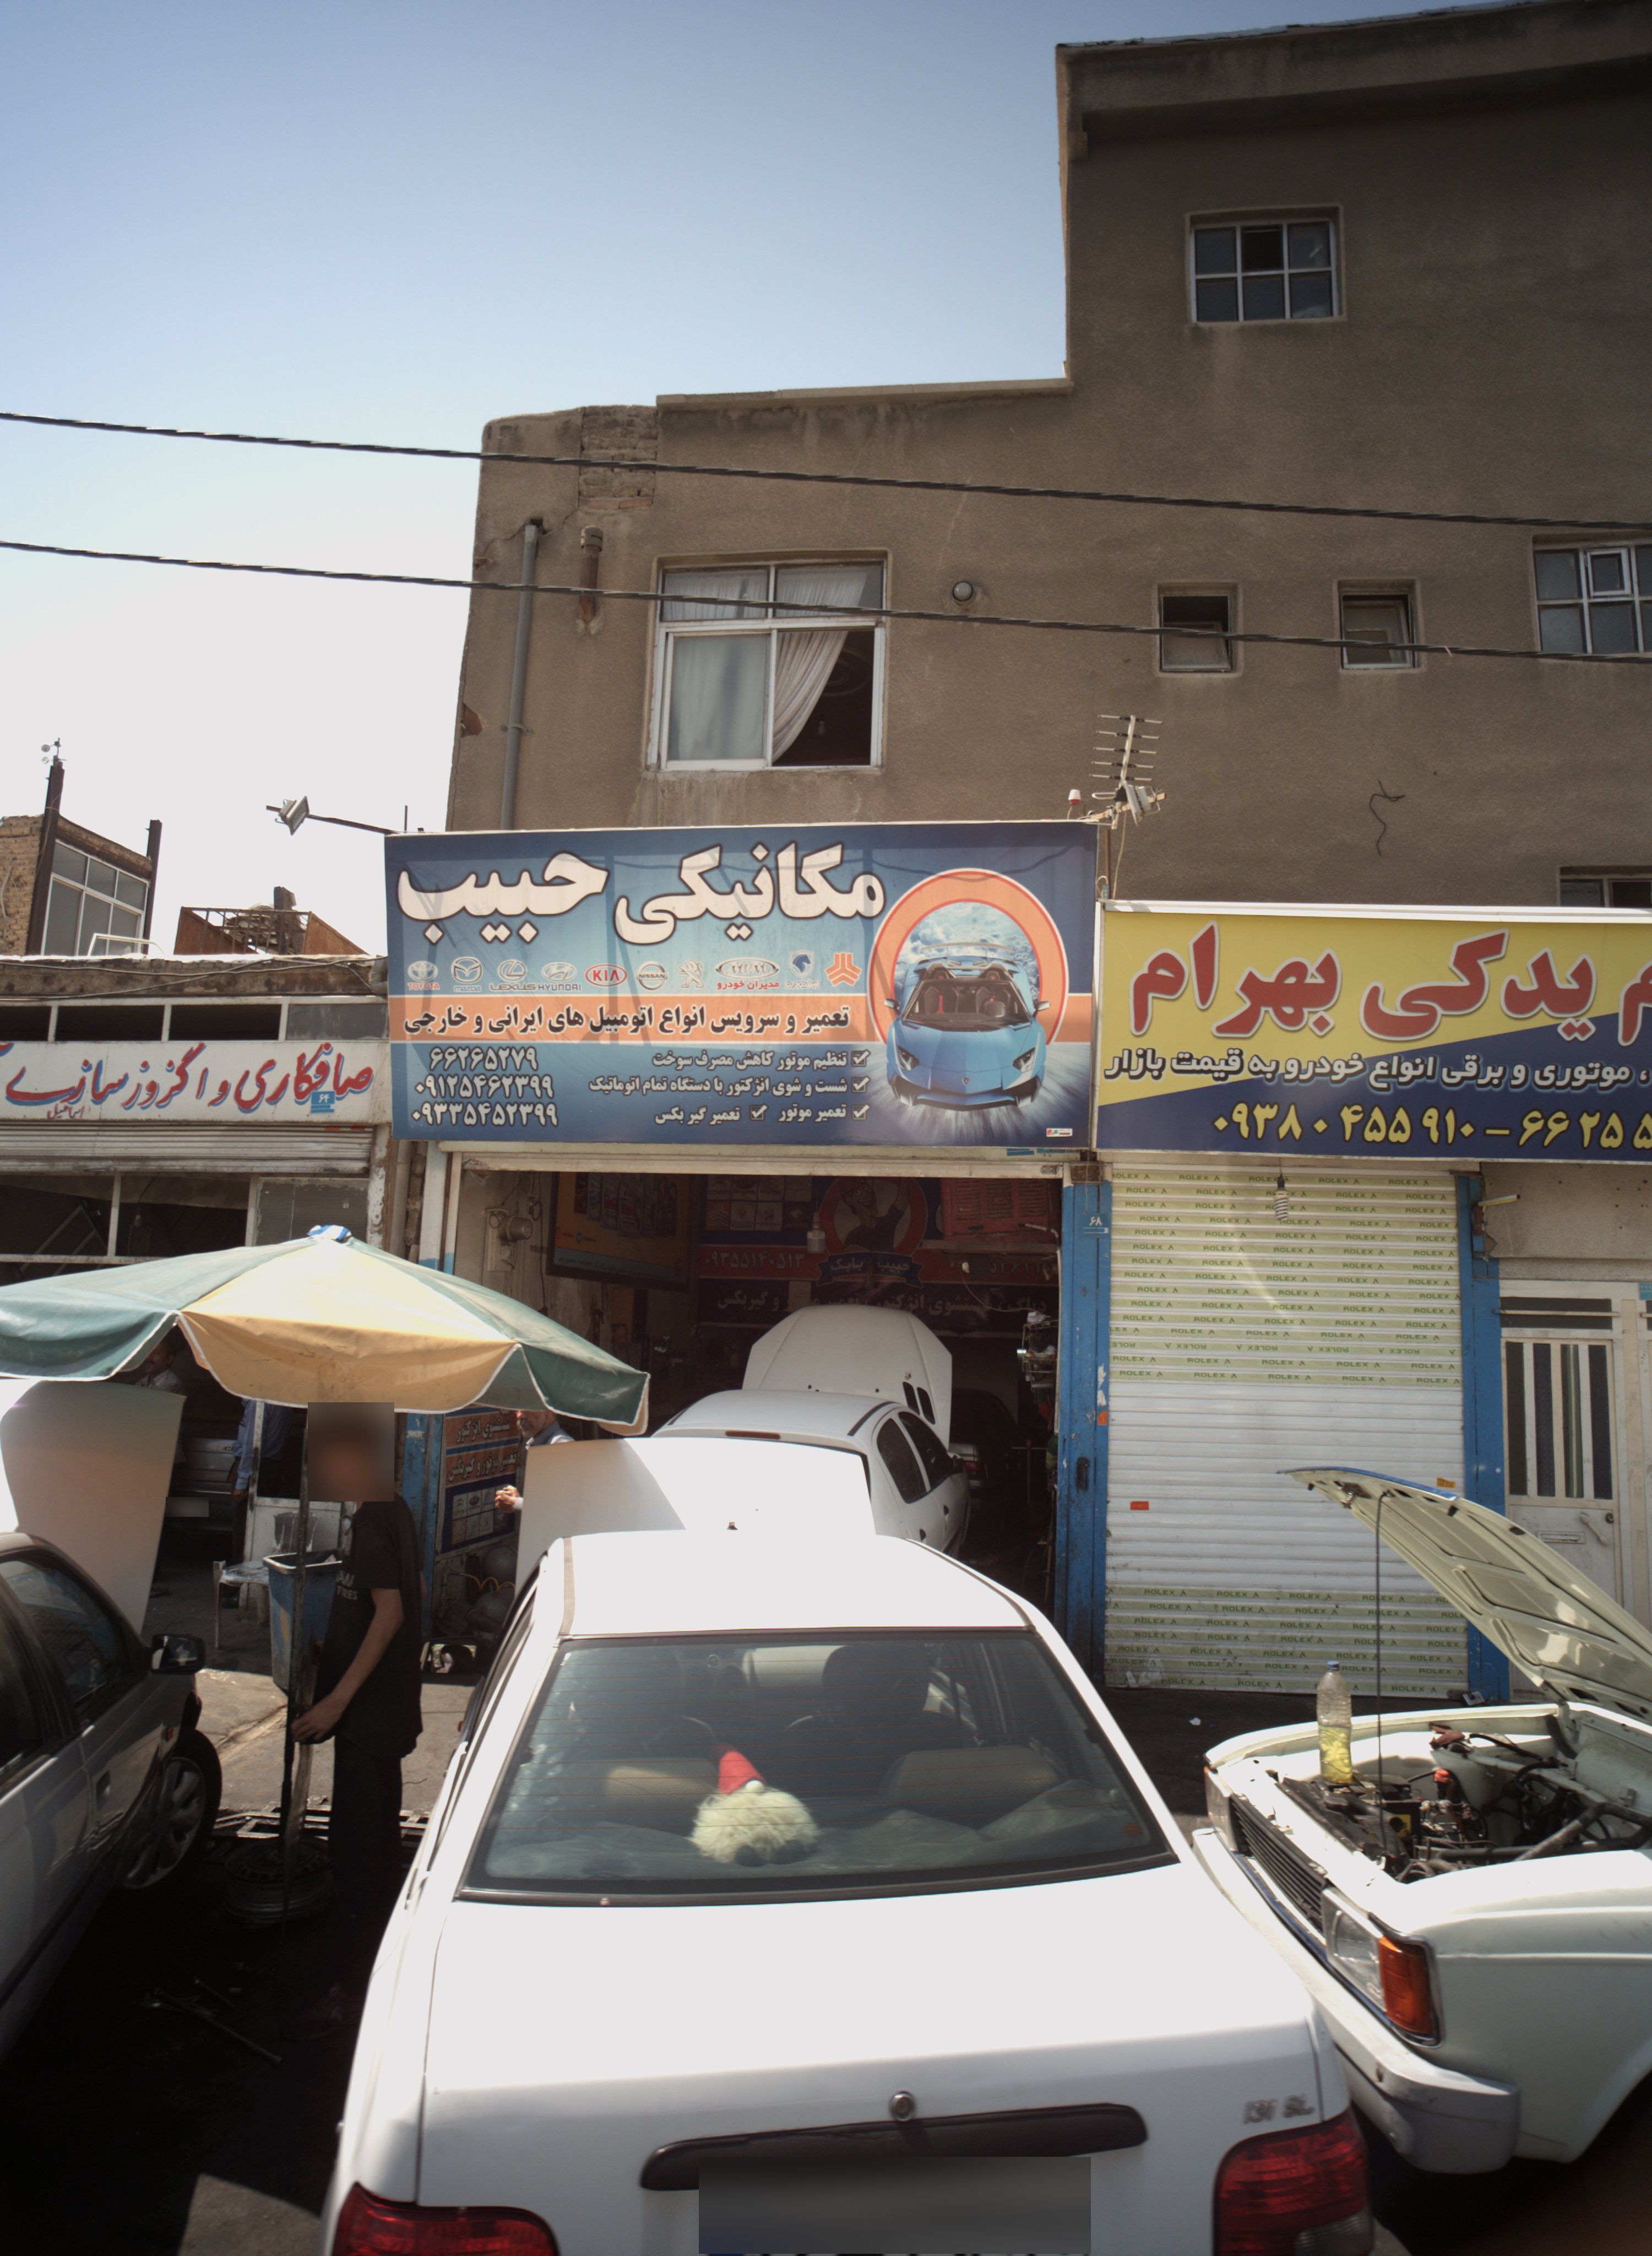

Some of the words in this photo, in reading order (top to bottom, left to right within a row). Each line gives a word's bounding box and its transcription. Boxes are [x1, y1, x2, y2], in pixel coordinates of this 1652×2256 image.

[397, 849, 610, 943] حبیب
[613, 840, 885, 946] مکانیکی
[592, 968, 620, 982] KIA
[717, 980, 745, 990] خودرو
[747, 980, 780, 990] مدیران
[1129, 920, 1341, 1038] بهرام
[1359, 928, 1597, 1042] یدکی
[407, 982, 439, 990] TOYOTA
[404, 1005, 468, 1034] خارجی
[473, 1014, 483, 1034] و
[488, 1005, 542, 1034] ایرانی
[548, 1006, 585, 1033] های
[590, 1005, 654, 1034] اتومبیل
[659, 1004, 705, 1034] انواع
[710, 1011, 780, 1034] سرویس
[785, 1013, 796, 1033] و
[802, 1005, 850, 1034] تعمیر
[430, 1046, 538, 1071] ۶۶۲۶۵۲۷۹
[652, 1052, 692, 1070] سوخت
[695, 1050, 733, 1070] مصرف
[736, 1050, 773, 1070] کاهش
[776, 1053, 810, 1071] موتور
[813, 1050, 847, 1070] تنظیم
[1104, 1048, 1166, 1080] بازار
[1170, 1048, 1245, 1082] قیمت
[1248, 1054, 1278, 1082] به
[1283, 1053, 1365, 1083] خودرو
[234, 1043, 373, 1113] صافکاری
[1369, 1054, 1437, 1088] انواع
[1441, 1054, 1507, 1088] برقی
[1510, 1064, 1528, 1087] و
[1534, 1062, 1632, 1090] موتوری
[208, 1080, 231, 1107] و
[415, 1074, 554, 1098] ۰۹۱۲۵۴۶۲۳۹۹
[589, 1076, 640, 1095] اتوماتیک
[642, 1076, 667, 1096] تمام
[670, 1077, 710, 1093] دستگاه
[713, 1077, 724, 1094] با
[726, 1076, 770, 1096] انژکتور
[772, 1078, 801, 1096] شوی
[805, 1082, 812, 1097] و
[814, 1077, 847, 1093] شست
[318, 1094, 330, 1103] ۶۴
[412, 1102, 558, 1126] ۰۹۳۳۵۴۵۲۳۹۹
[654, 1106, 684, 1125] بکس
[687, 1105, 707, 1126] گیر
[710, 1106, 741, 1126] تعمیر
[778, 1104, 812, 1122] موتور
[815, 1103, 847, 1124] تعمیر
[1089, 1216, 1103, 1226] ۶۸
[830, 1259, 863, 1272] بابک
[877, 1260, 910, 1273] حبیب
